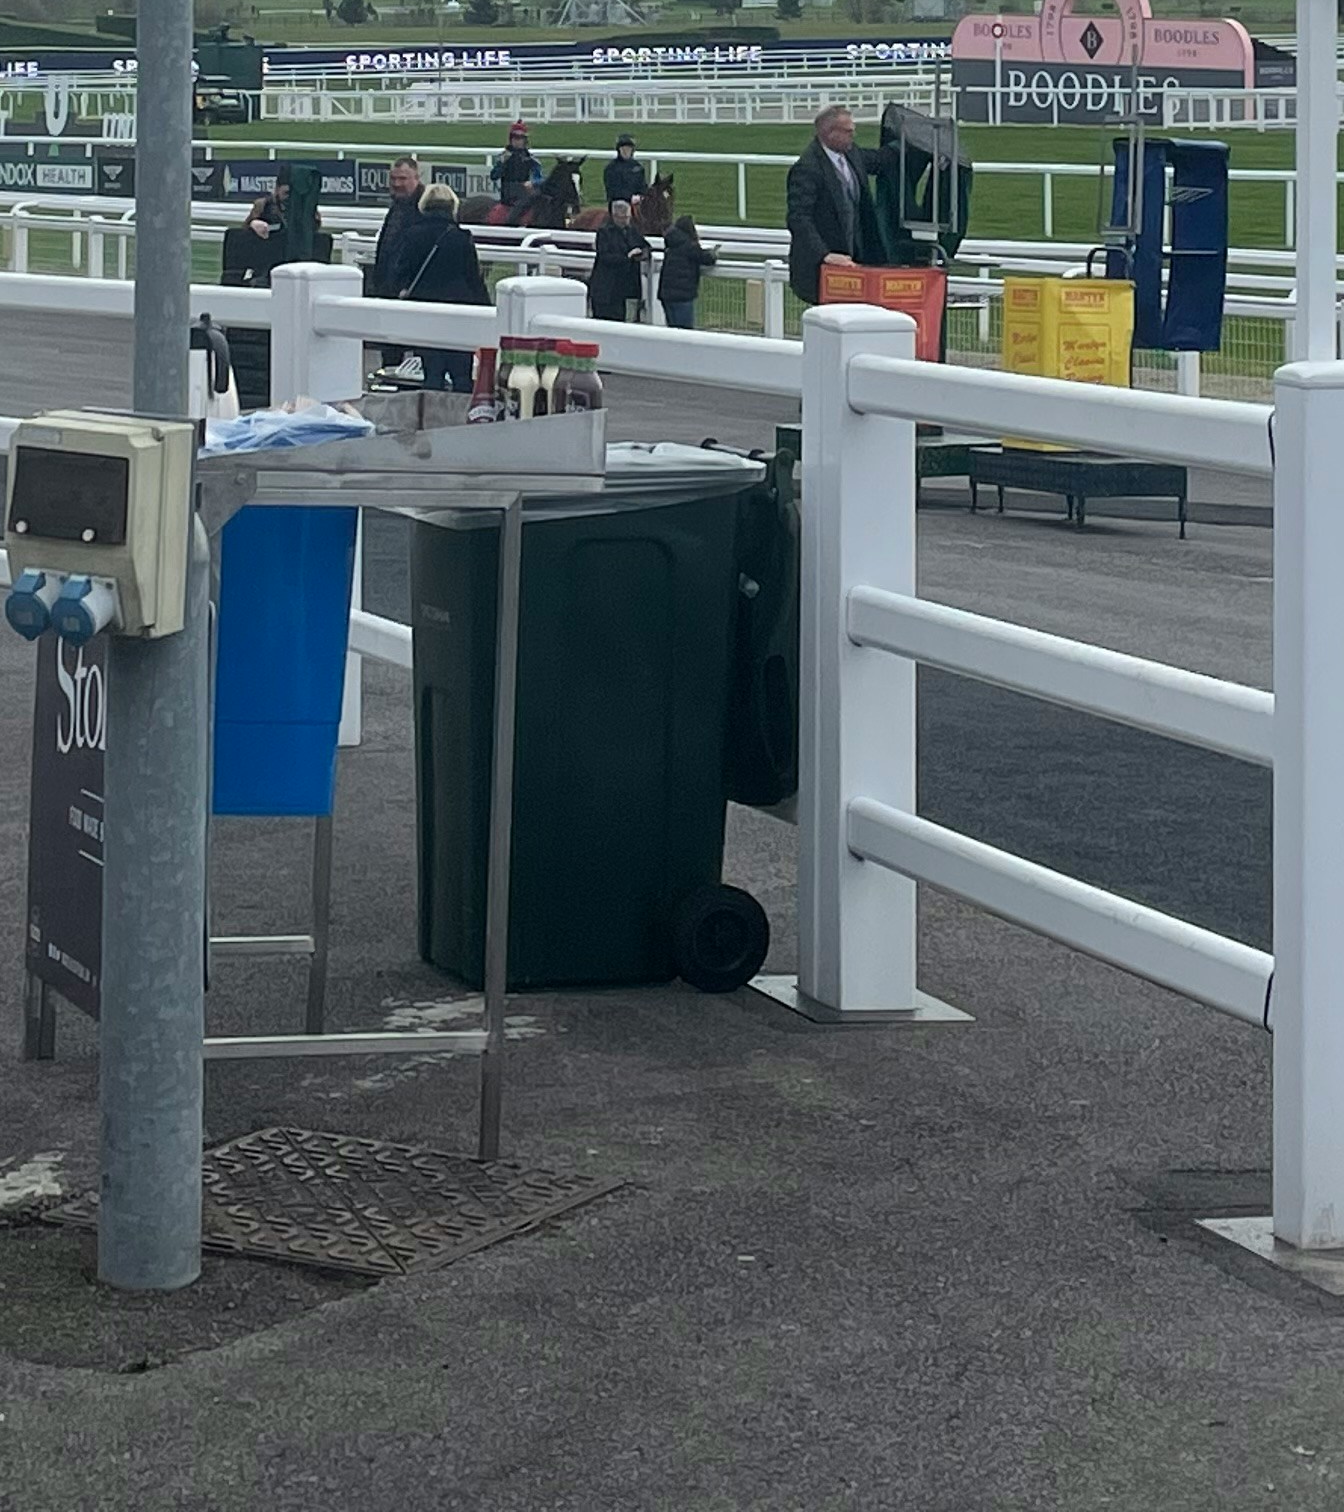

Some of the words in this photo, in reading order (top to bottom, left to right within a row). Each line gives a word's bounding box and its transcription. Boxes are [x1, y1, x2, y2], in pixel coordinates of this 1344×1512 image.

[973, 22, 1032, 40] BODLES
[1087, 30, 1098, 49] B
[1154, 28, 1220, 46] BOODLES
[345, 52, 455, 72] SPORTING
[462, 50, 511, 67] LIFE
[592, 46, 709, 64] SPORTING
[714, 45, 762, 62] LIFE
[42, 166, 86, 184] HEALTH
